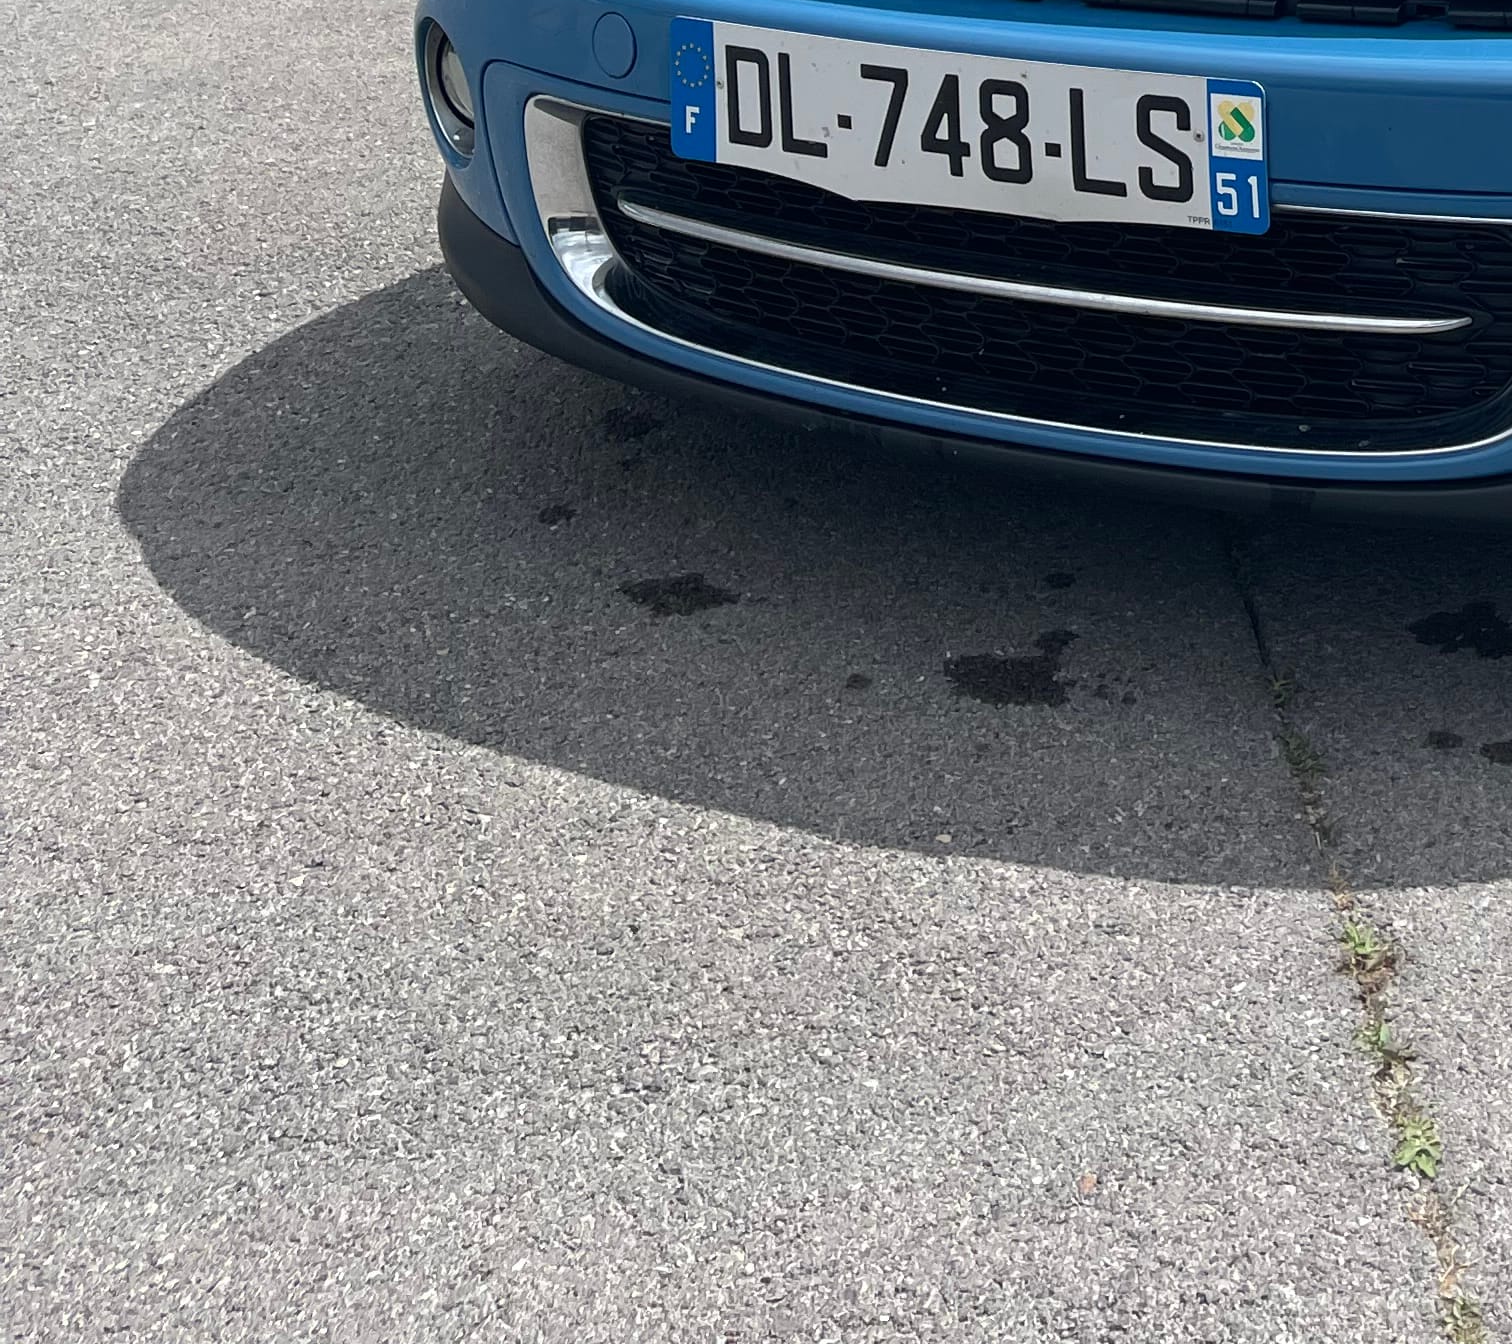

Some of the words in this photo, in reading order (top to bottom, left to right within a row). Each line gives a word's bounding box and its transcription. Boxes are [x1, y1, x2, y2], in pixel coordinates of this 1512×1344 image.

[685, 105, 701, 134] F
[725, 44, 1194, 203] DL-748-LS
[1216, 172, 1260, 219] 51
